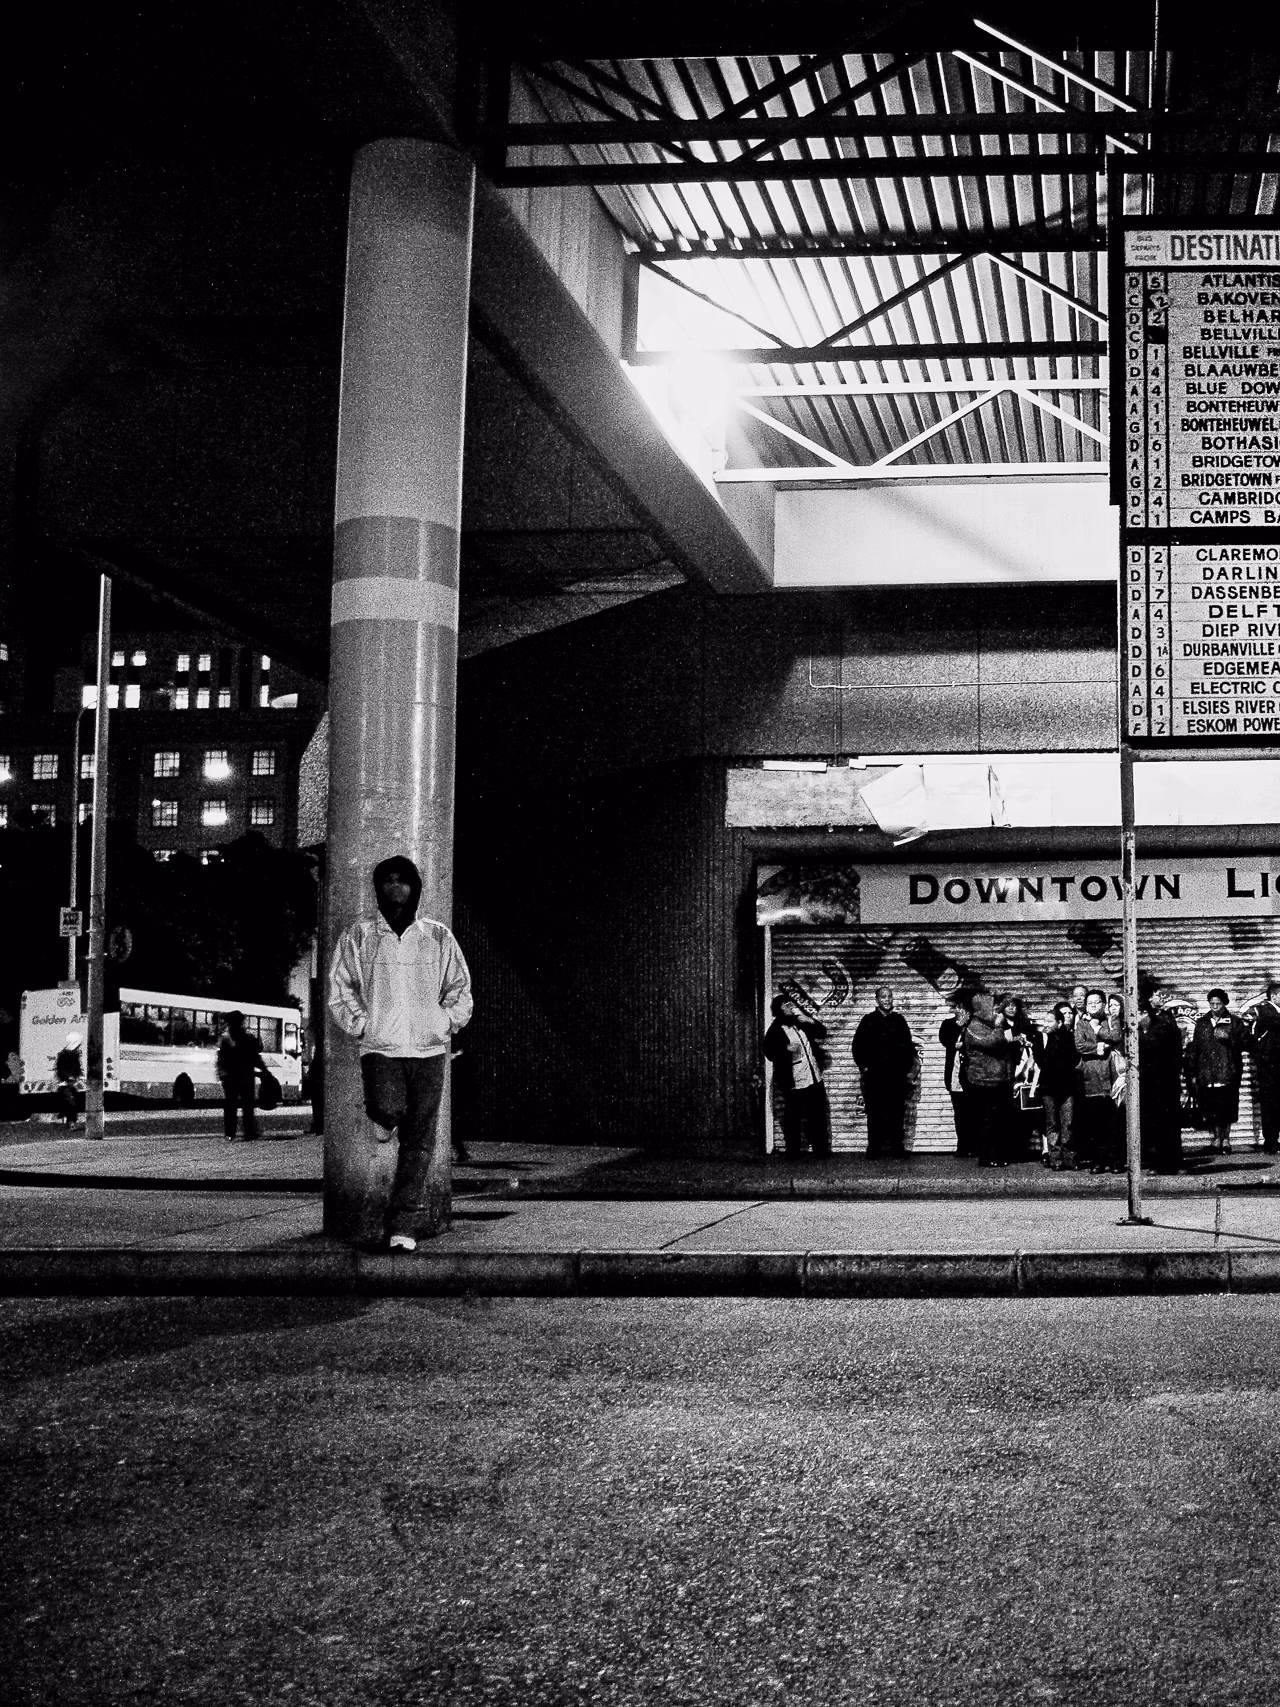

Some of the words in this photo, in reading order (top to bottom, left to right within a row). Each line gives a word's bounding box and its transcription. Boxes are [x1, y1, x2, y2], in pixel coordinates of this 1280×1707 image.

[1183, 346, 1259, 359] BELLVILLE
[1186, 382, 1227, 395] BLUE
[1181, 418, 1278, 432] BONTEHEUWEL
[1181, 473, 1272, 487] BRIDGETOWN
[1190, 510, 1251, 524] CAMPS
[1132, 552, 1140, 562] D
[1155, 552, 1162, 563] 2
[1132, 571, 1140, 581] D
[1156, 571, 1163, 581] 7
[1132, 590, 1141, 600] D
[1156, 590, 1164, 599] 7
[1132, 609, 1139, 620] A
[1154, 609, 1163, 618] 4
[1202, 624, 1239, 637] DIEP
[1183, 643, 1274, 657] DURBANVILLE
[1191, 681, 1266, 694] ELECTRIC
[1183, 701, 1229, 714] ELSIES
[1236, 700, 1275, 713] RIVER
[1187, 719, 1237, 733] ESKOM
[32, 1015, 66, 1025] Golden
